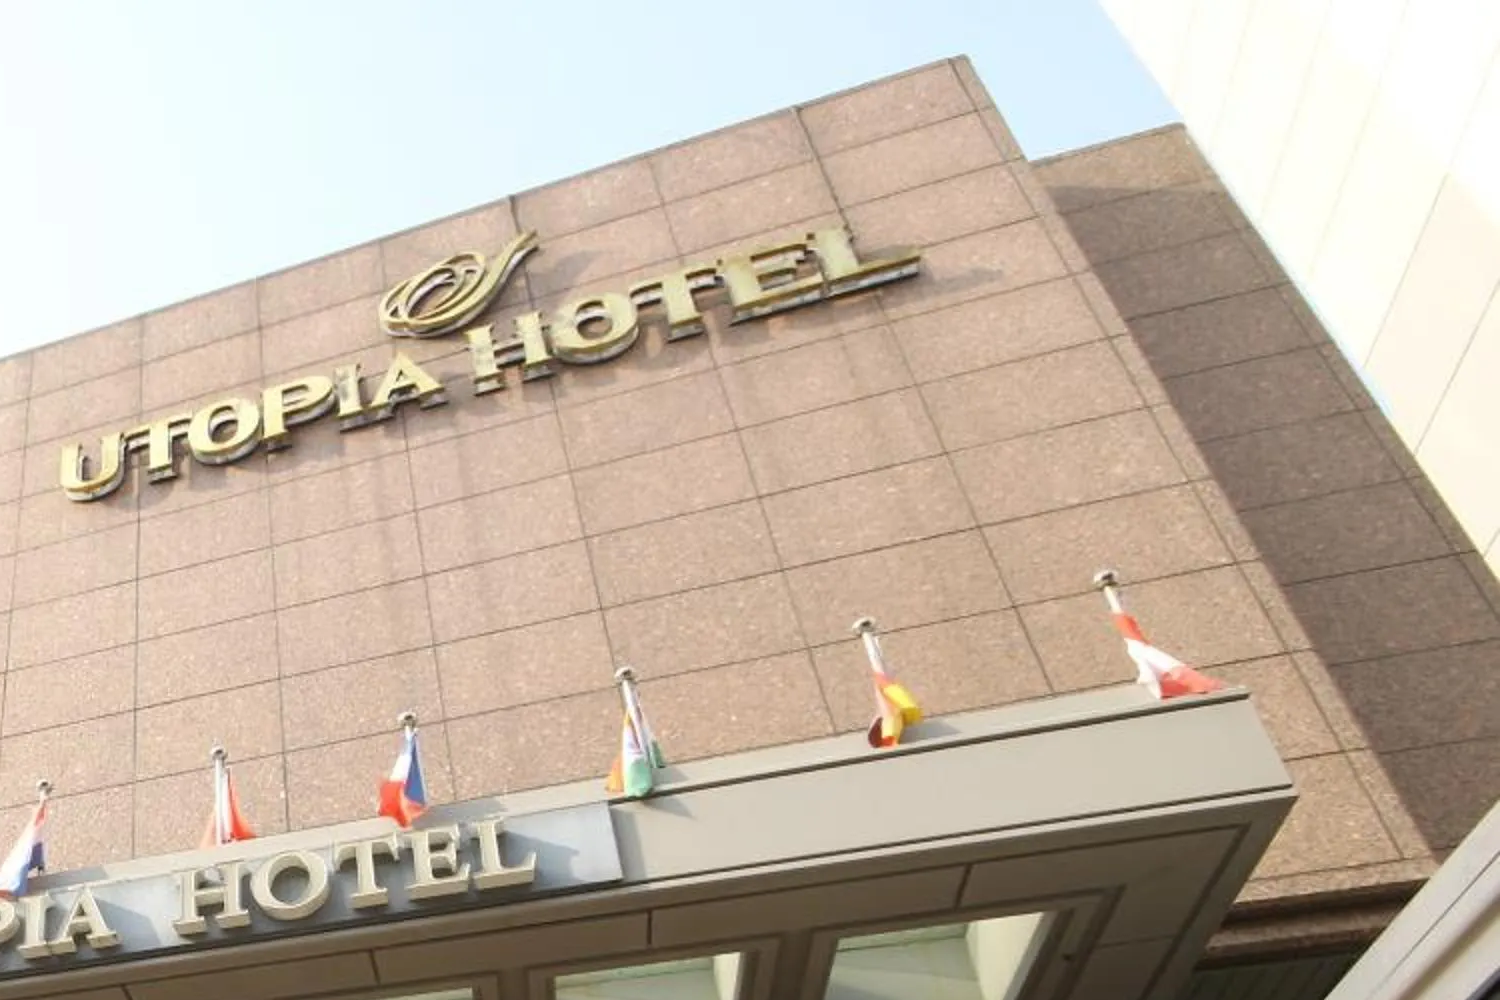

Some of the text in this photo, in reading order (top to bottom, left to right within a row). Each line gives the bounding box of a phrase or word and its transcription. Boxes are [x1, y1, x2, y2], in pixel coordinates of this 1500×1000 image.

[60, 227, 924, 502] UTOPIA HOTEL
[173, 820, 537, 937] HOTEL
